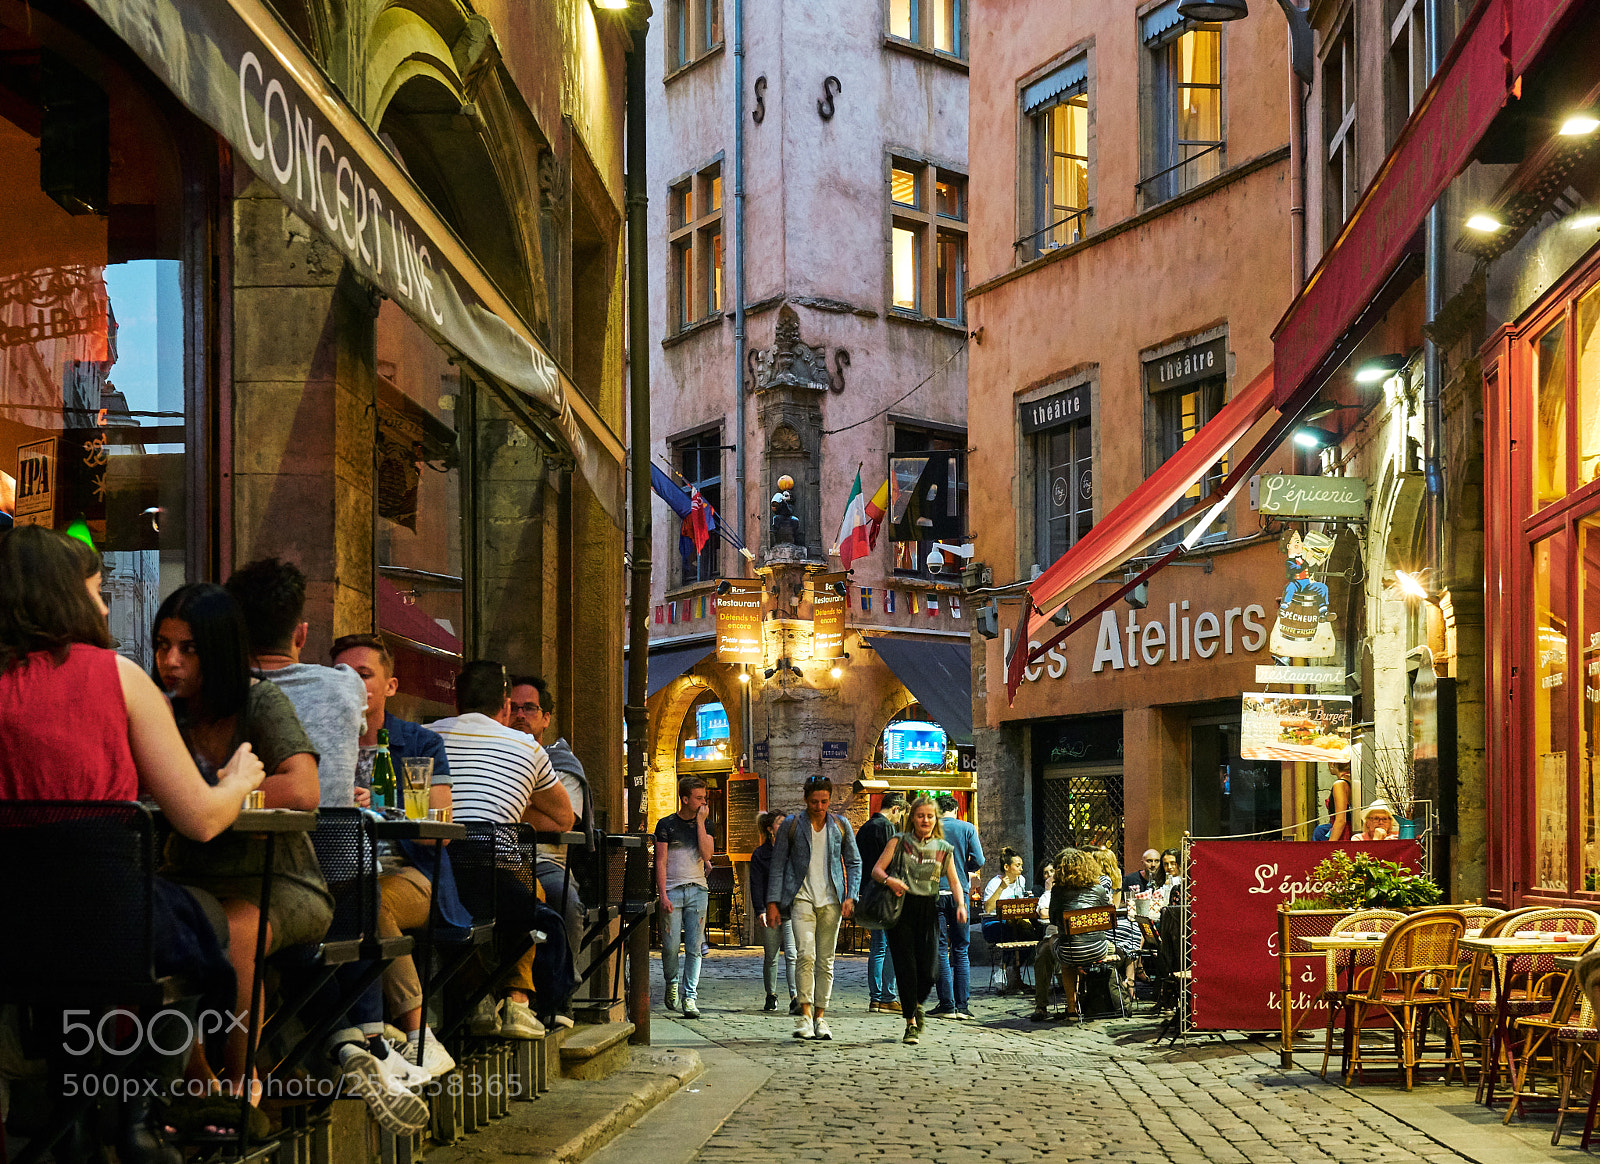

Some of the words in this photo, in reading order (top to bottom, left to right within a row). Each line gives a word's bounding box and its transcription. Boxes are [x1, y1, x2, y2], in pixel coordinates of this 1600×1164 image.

[239, 51, 382, 276] CONCERT
[391, 223, 444, 326] LIVE
[1159, 349, 1214, 382] théâtre
[1032, 395, 1081, 425] théâtre
[19, 455, 50, 498] IPA
[1262, 476, 1360, 514] L'épicerie
[717, 598, 760, 608] Restaurant
[719, 613, 748, 622] Détends
[1092, 600, 1266, 673] Ateliers
[1260, 666, 1343, 683] restaurant
[1314, 708, 1348, 724] Burger
[1300, 965, 1316, 983] à
